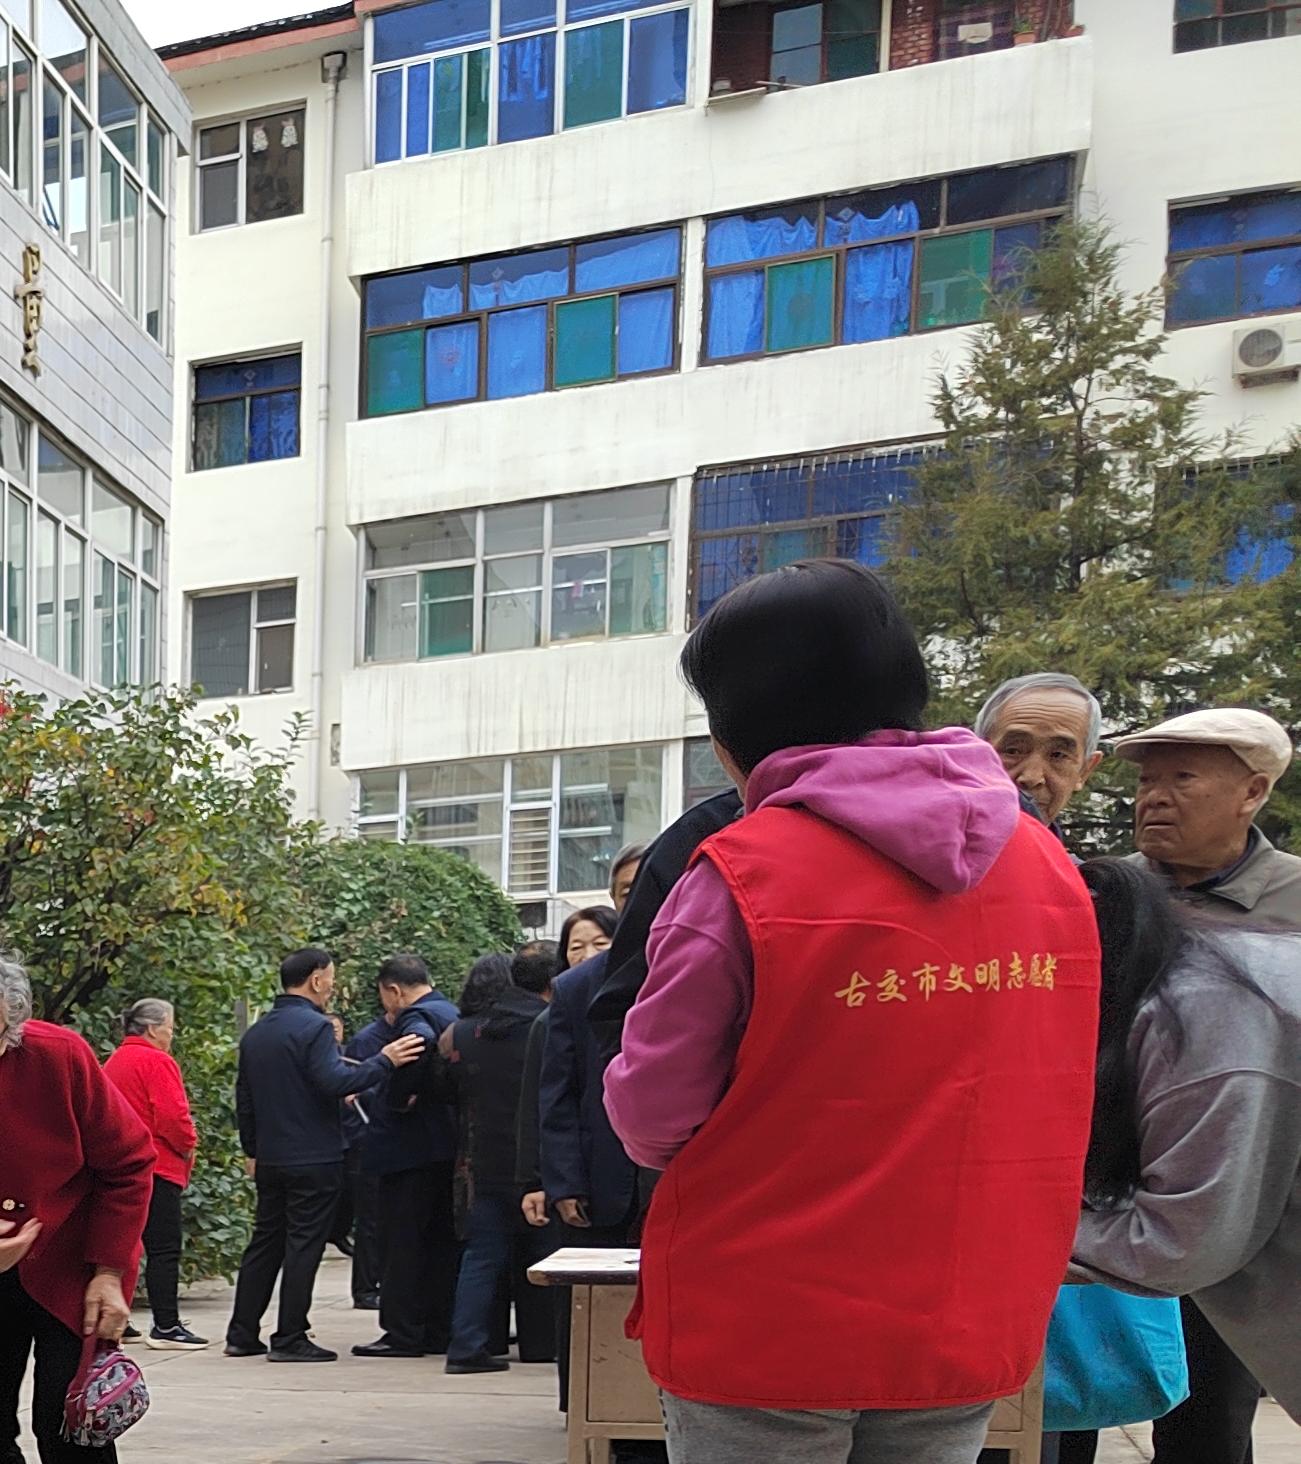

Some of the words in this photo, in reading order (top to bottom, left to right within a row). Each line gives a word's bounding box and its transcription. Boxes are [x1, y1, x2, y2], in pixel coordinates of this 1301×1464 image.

[834, 951, 1058, 1008] 古交市文明志愿者
